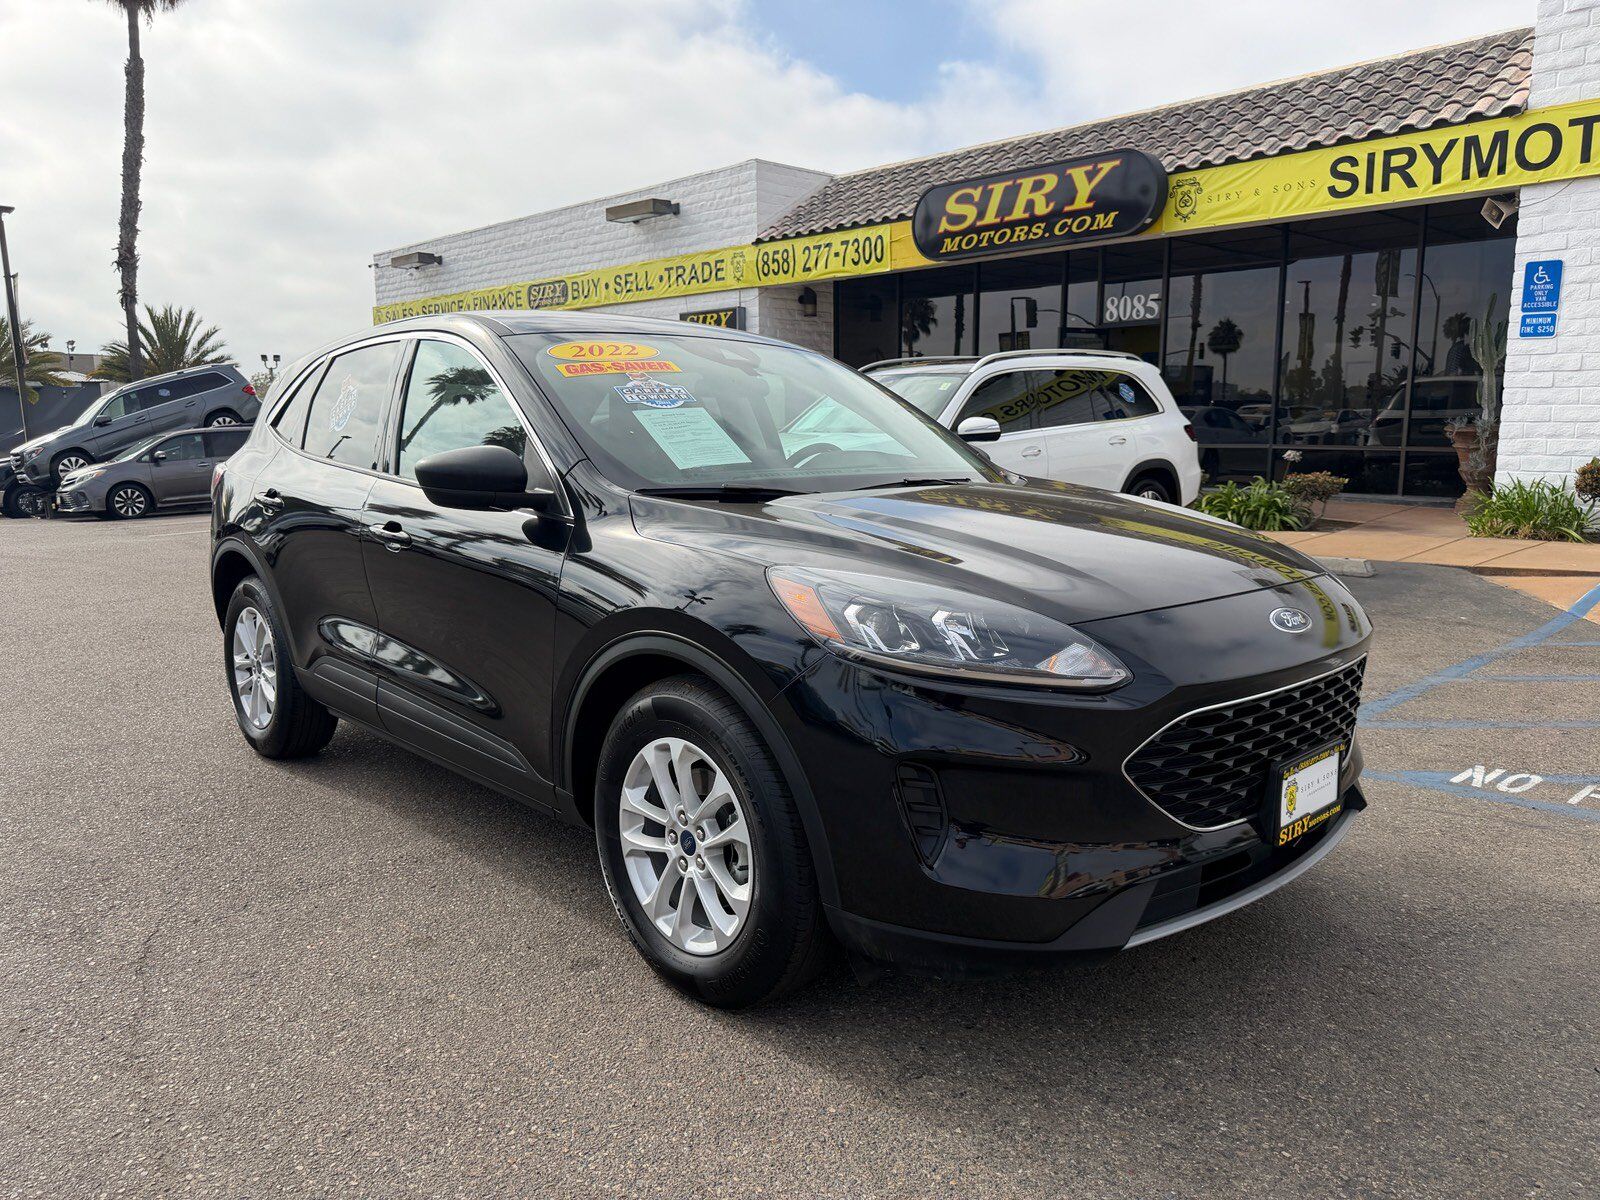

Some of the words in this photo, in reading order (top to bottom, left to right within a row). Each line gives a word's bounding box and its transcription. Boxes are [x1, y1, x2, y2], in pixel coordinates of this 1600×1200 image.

[1326, 114, 1600, 200] SIRYMOT
[938, 159, 1123, 234] SIRY
[1206, 190, 1243, 204] SIRY
[1253, 187, 1263, 197] &
[1273, 179, 1317, 194] SONS
[939, 211, 1120, 254] MOTORS.COM
[755, 244, 796, 281] (858)
[802, 234, 885, 273] 277-7300
[571, 278, 601, 300] BUY
[613, 270, 655, 295] SELL
[664, 259, 726, 288] TRADE
[473, 290, 522, 311] FINANCE
[1105, 293, 1160, 322] 8085
[1523, 301, 1557, 309] ACCESSIBLE
[1521, 326, 1534, 334] FINE
[1537, 325, 1555, 333] $250
[1525, 317, 1552, 325] MINIMUM
[569, 344, 639, 358] 2022
[564, 361, 674, 374] GAS-SAVER
[1280, 611, 1306, 628] Ford
[1450, 764, 1544, 794] NO
[1279, 814, 1311, 847] SIRY
